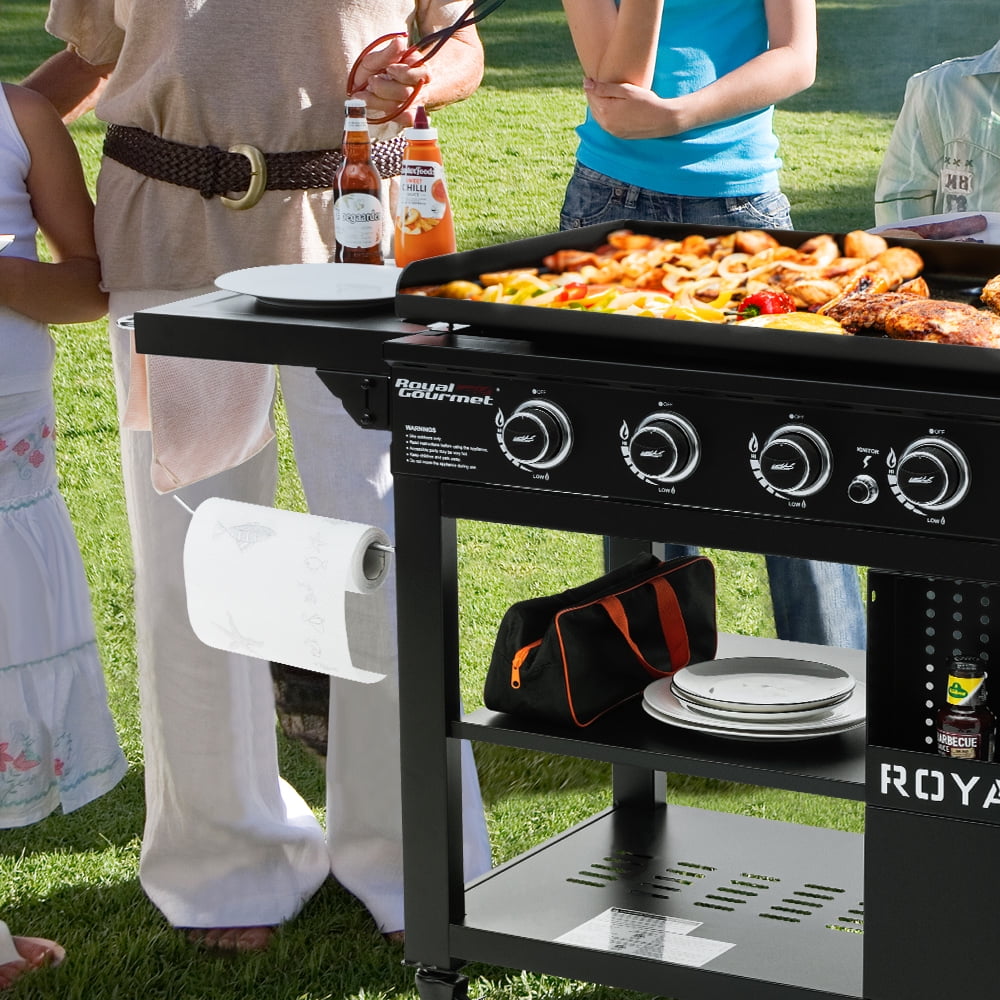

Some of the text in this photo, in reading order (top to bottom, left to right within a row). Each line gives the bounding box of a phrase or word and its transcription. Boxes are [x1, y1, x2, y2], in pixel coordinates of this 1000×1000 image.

[402, 184, 427, 193] CHILLI
[395, 378, 455, 392] Royal
[398, 387, 493, 406] Gourmet
[405, 425, 437, 433] WARNINGS
